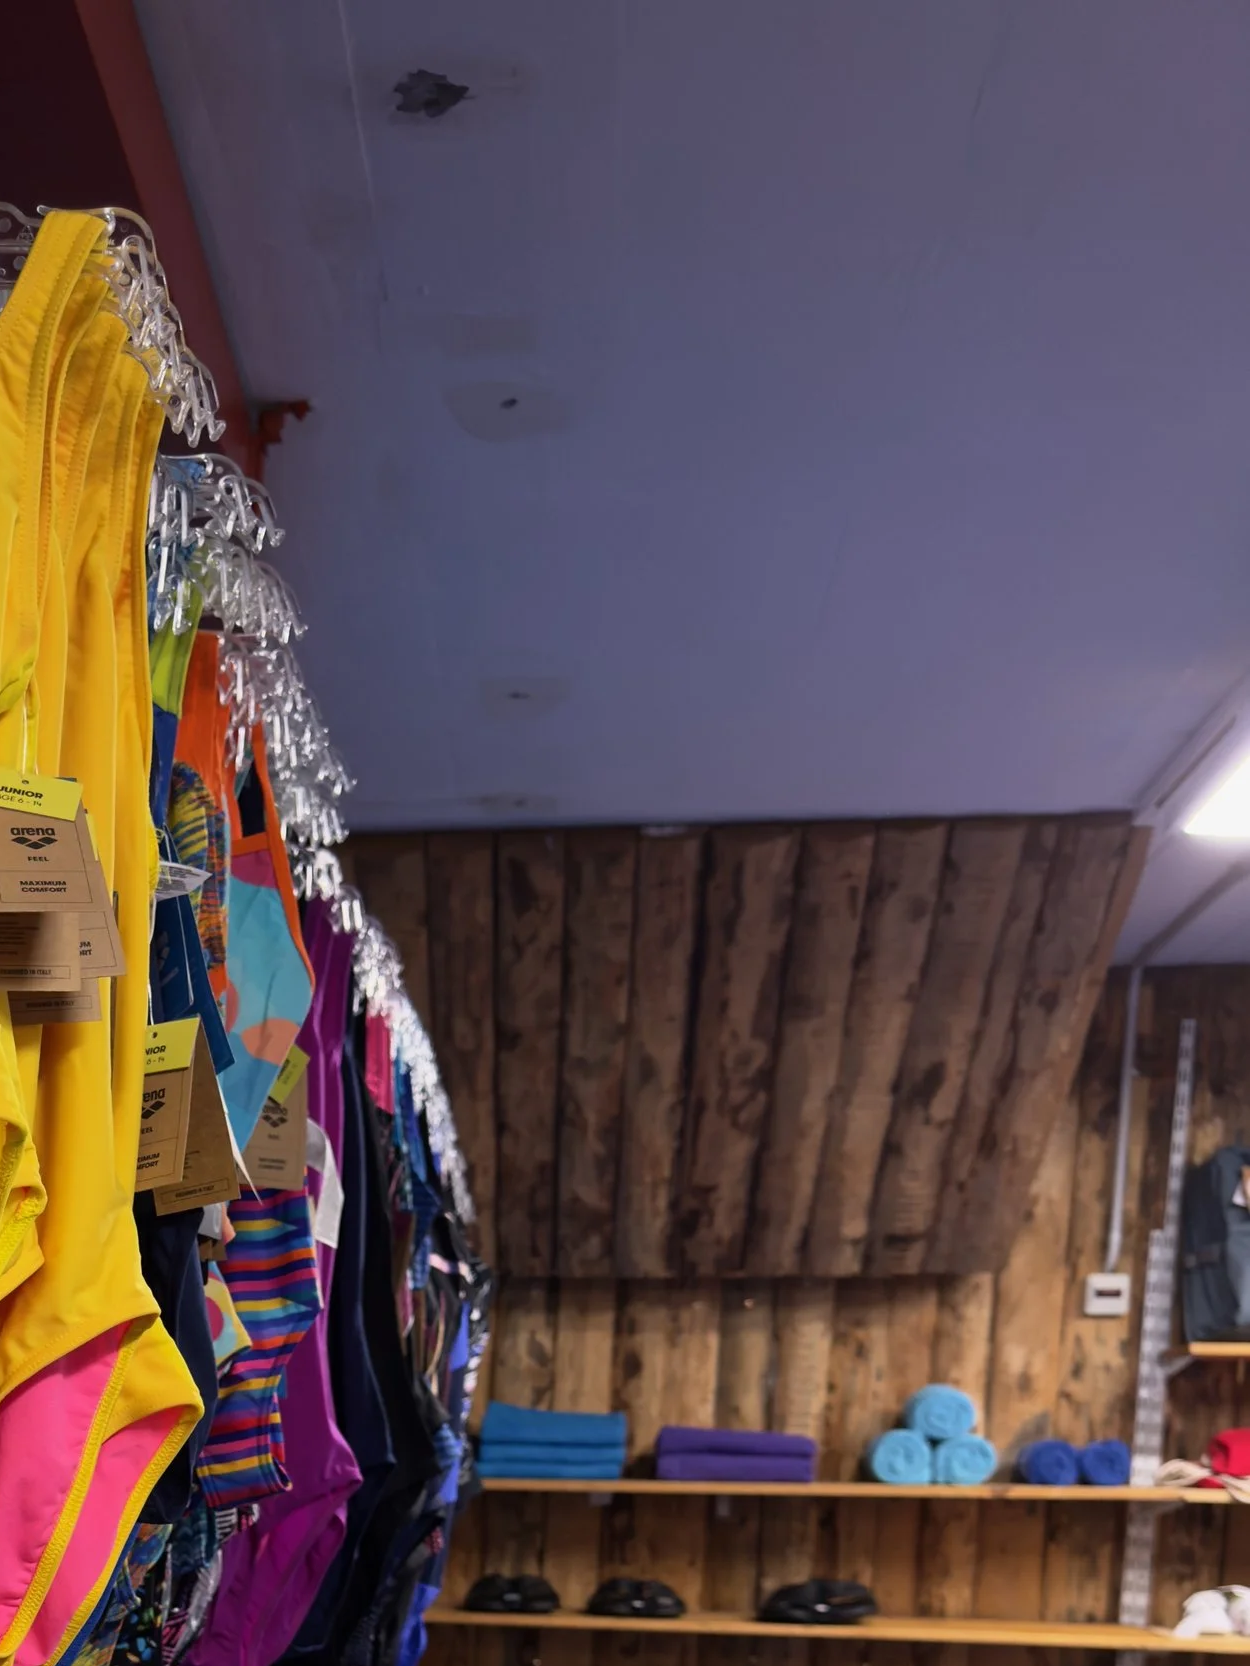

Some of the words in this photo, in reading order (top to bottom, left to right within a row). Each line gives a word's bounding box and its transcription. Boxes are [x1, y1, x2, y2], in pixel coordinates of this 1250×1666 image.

[10, 827, 56, 836] arena
[145, 1045, 166, 1055] NIOR
[142, 1088, 166, 1103] ena
